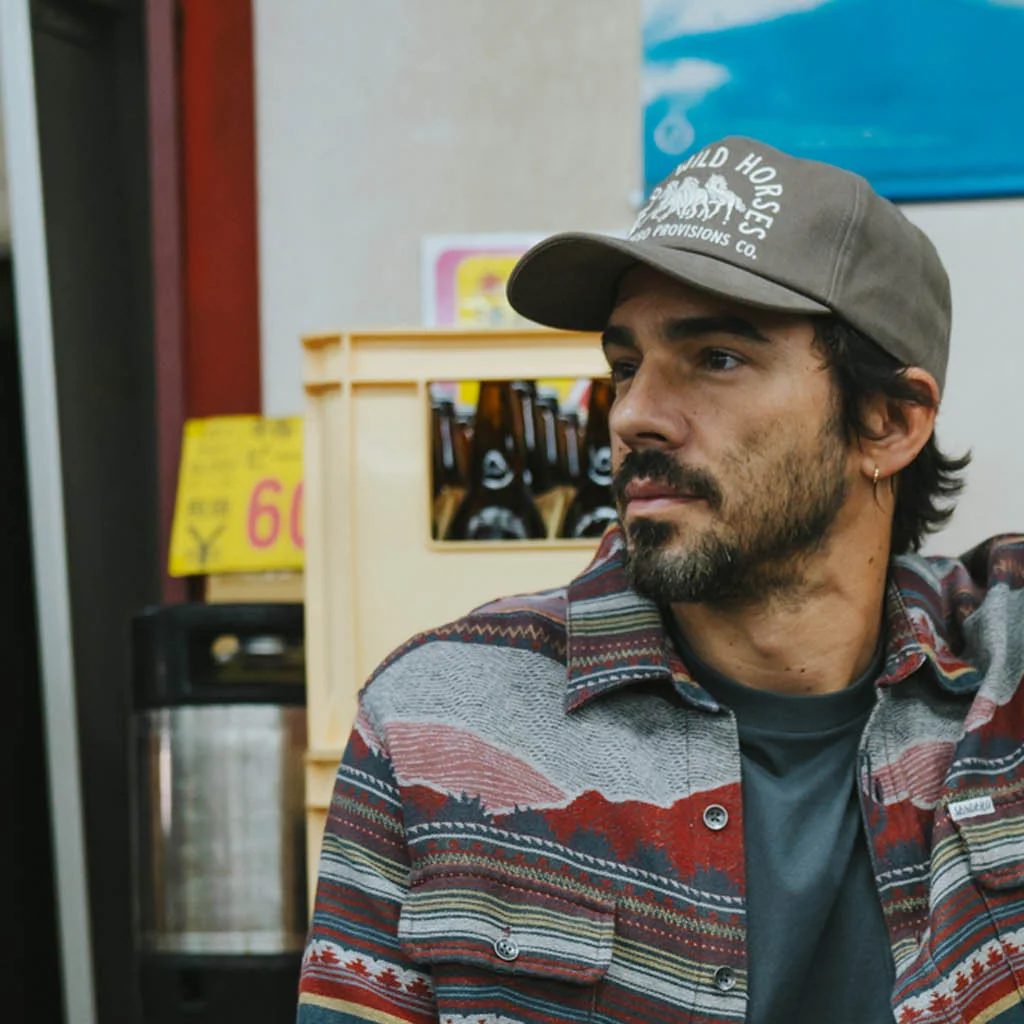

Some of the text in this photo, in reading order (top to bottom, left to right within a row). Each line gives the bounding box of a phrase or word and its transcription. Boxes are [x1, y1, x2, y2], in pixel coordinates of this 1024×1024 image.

[675, 146, 729, 177] WILD
[734, 152, 783, 240] HORSES
[652, 223, 732, 247] PROVISIONS
[735, 239, 757, 260] CO.
